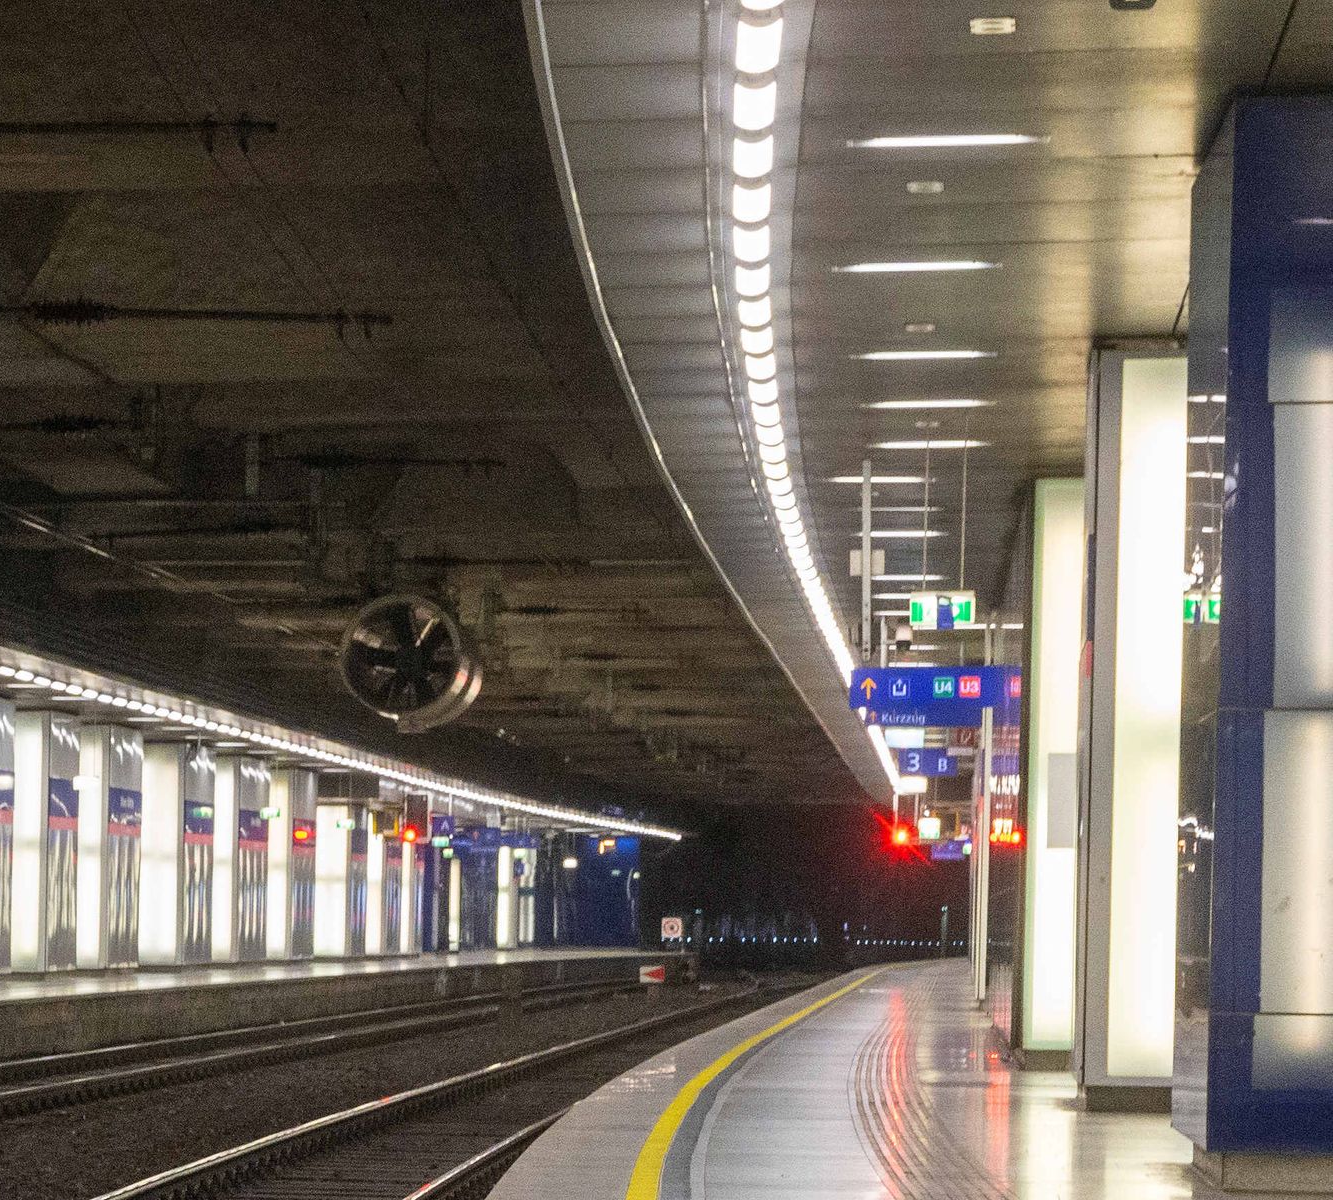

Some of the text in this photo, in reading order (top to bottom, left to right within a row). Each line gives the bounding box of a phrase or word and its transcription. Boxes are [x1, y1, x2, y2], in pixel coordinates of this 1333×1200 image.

[934, 681, 979, 694] U4 U3
[882, 713, 925, 725] Kurzzug
[907, 753, 948, 772] 3 B
